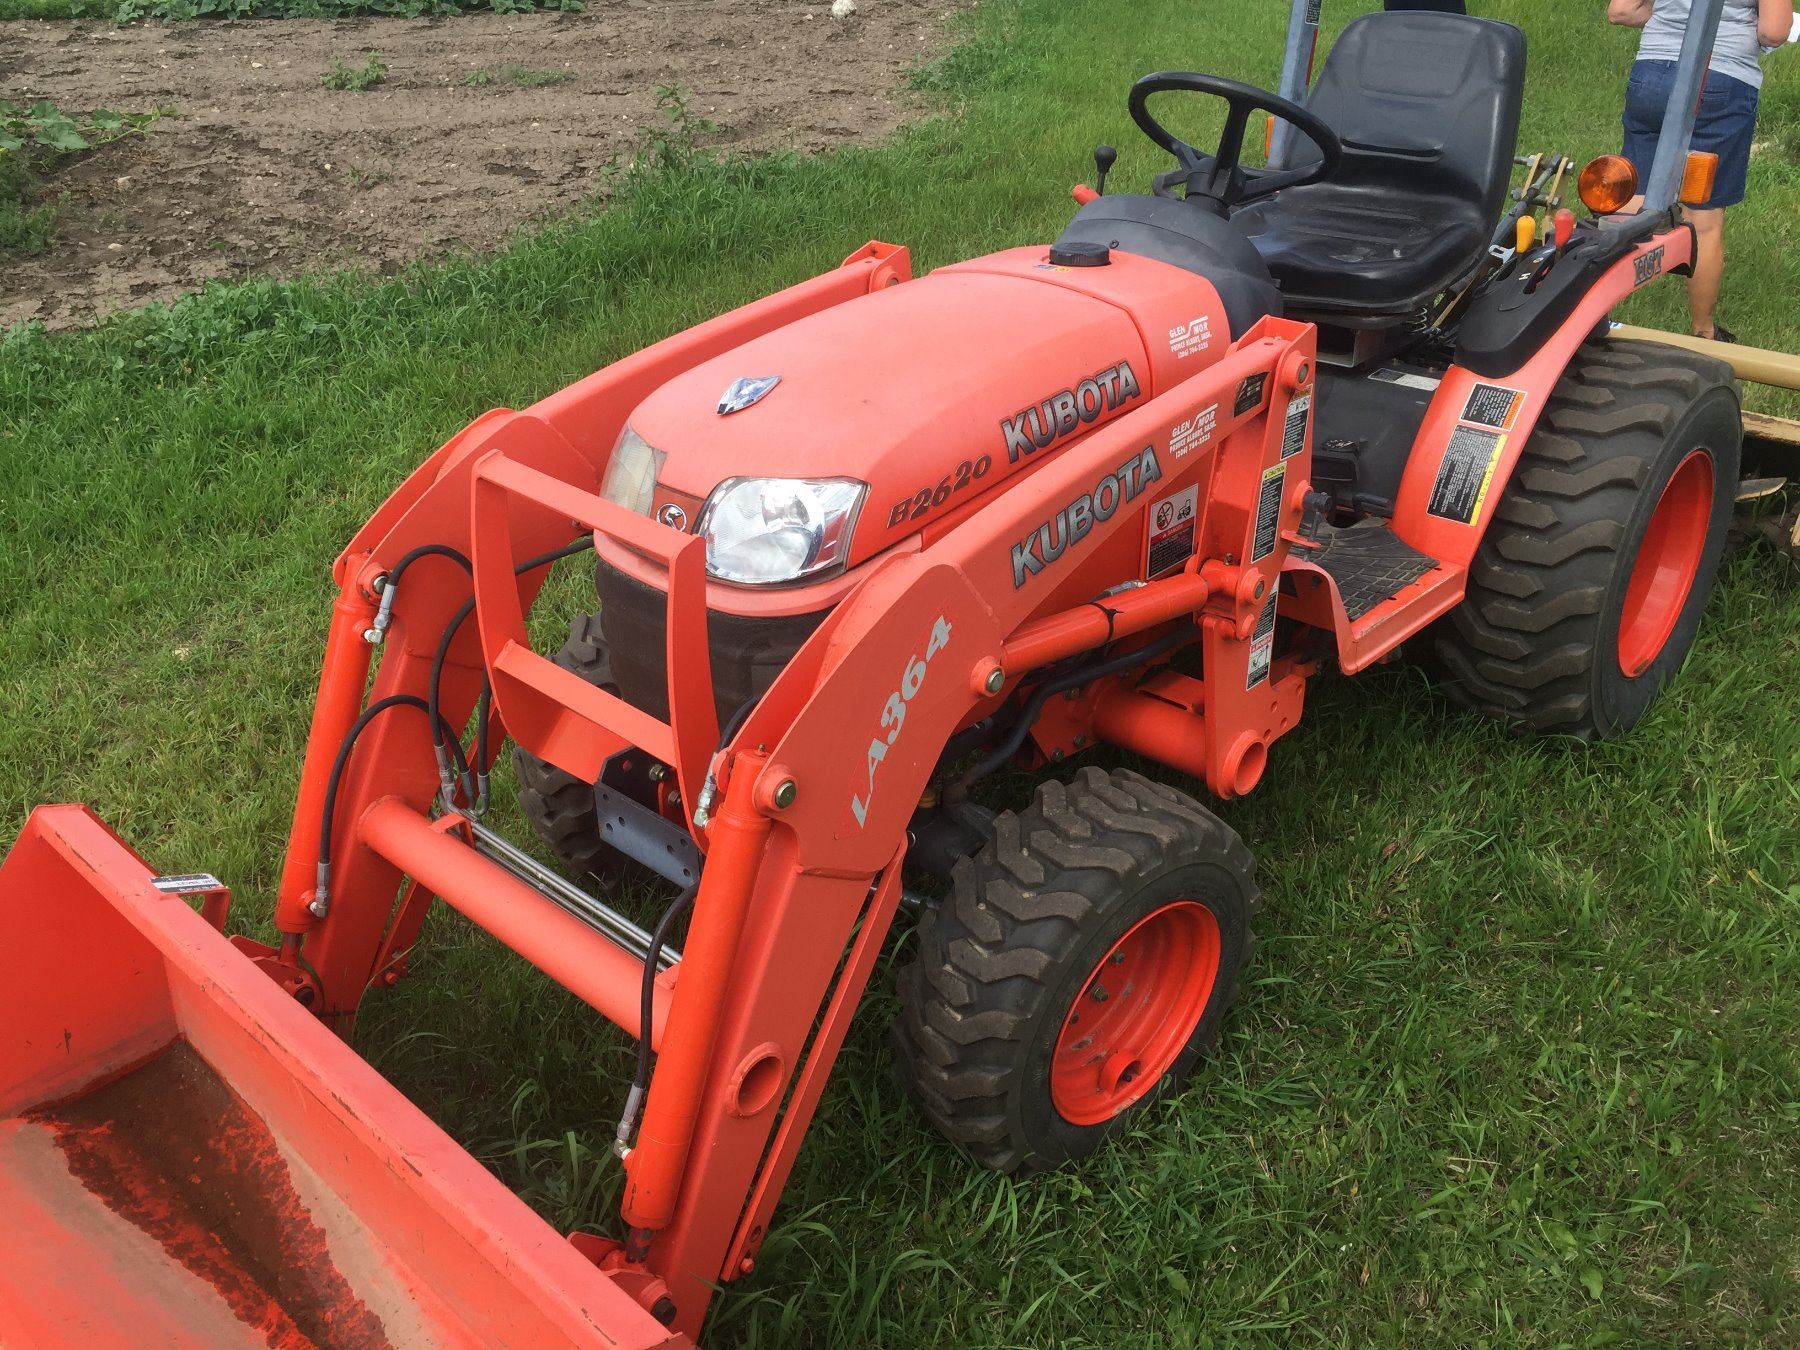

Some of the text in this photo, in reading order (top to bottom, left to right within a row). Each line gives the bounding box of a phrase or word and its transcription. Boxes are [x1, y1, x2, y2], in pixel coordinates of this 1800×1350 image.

[1169, 322, 1208, 338] GLEN MOR
[1000, 360, 1141, 464] KUBOTA
[1172, 411, 1215, 437] GLEN MOR
[887, 455, 992, 528] B2620
[1011, 445, 1163, 589] KUBOTA
[852, 614, 952, 830] LA364
